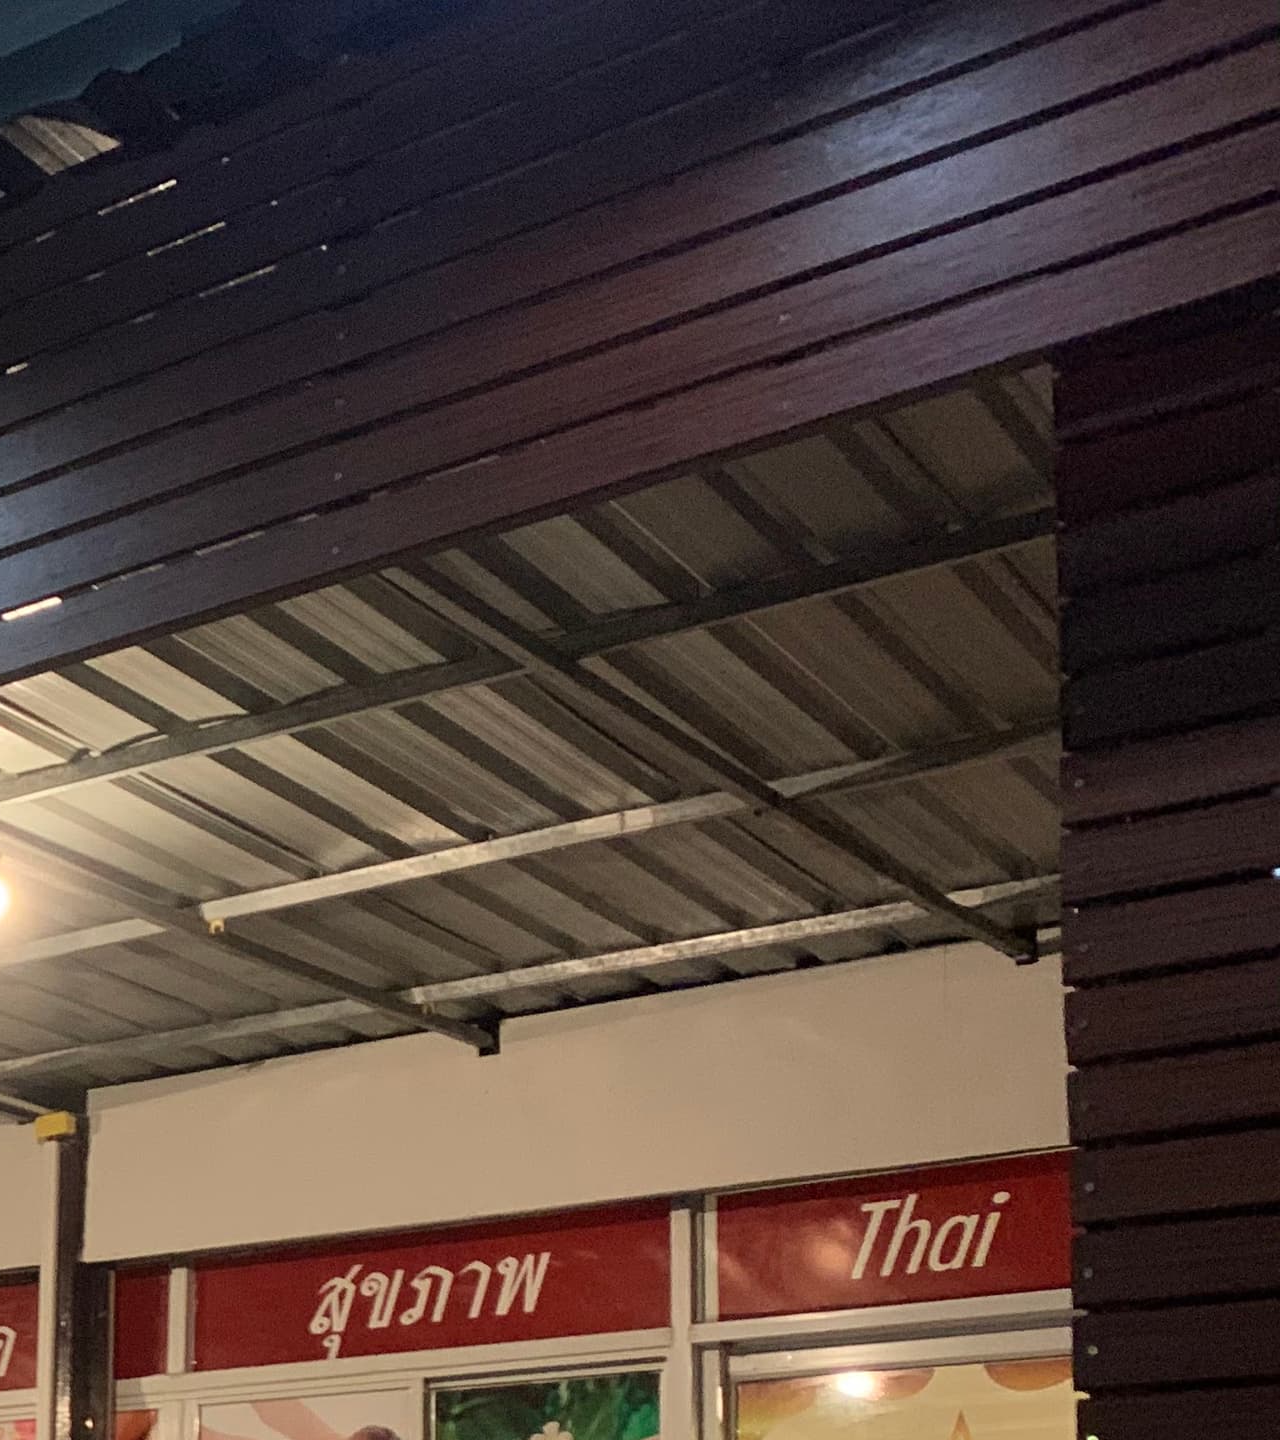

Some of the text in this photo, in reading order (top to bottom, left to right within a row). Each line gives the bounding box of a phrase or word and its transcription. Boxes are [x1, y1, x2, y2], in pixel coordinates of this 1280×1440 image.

[851, 1191, 1011, 1280] Thai
[308, 1251, 552, 1359] สุขภาพ
